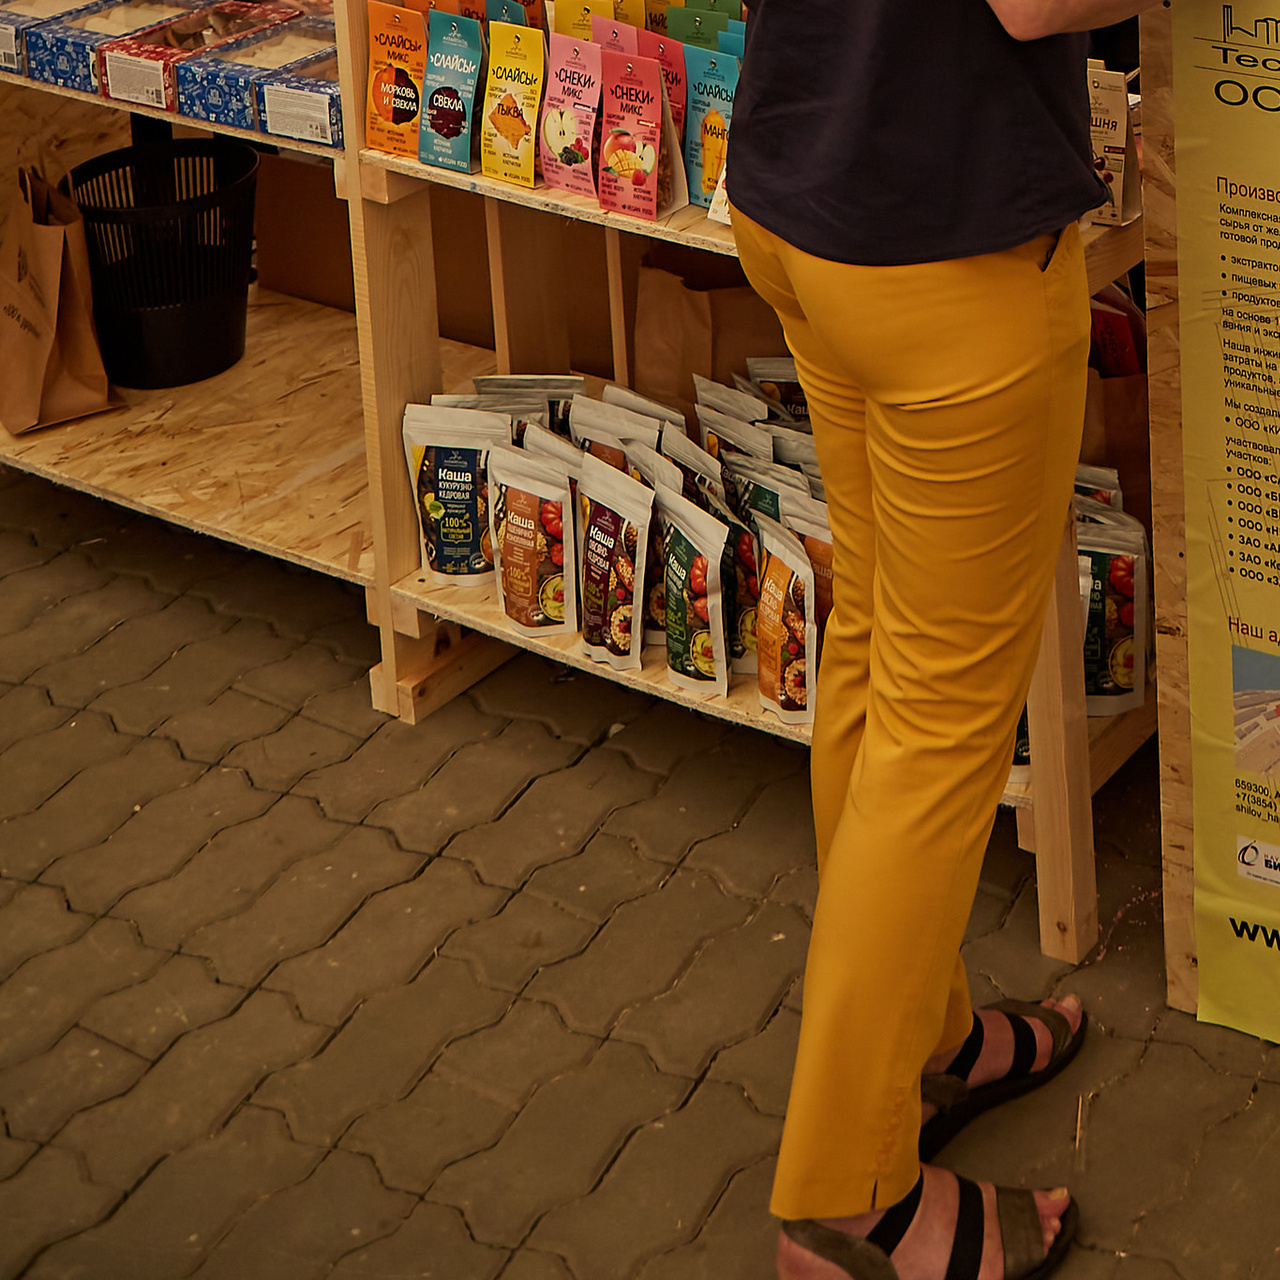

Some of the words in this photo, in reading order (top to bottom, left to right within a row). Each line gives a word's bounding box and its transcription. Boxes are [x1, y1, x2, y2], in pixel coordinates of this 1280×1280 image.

[379, 33, 417, 51] СЛАЙСЫ
[387, 50, 409, 63] МИКС
[433, 53, 472, 73] СЛАЙСЫ
[496, 66, 533, 86] СЛАЙСЫ
[558, 68, 591, 89] СНЕКИ
[381, 83, 415, 99] МОРКОВЬ
[561, 86, 583, 100] МИКС
[615, 85, 649, 104] СНЕКИ
[384, 96, 389, 105] И
[391, 98, 417, 112] СВЕКЛА
[433, 94, 463, 112] СВЕКЛА
[497, 103, 524, 120] ТЫКВА
[620, 102, 643, 116] МИКС
[1220, 218, 1250, 231] сырья
[1253, 224, 1264, 234] от
[1220, 231, 1257, 246] готовой
[1235, 417, 1260, 431] ООО
[438, 468, 472, 482] Каша
[439, 481, 474, 491] КУКУРУЗНО-
[439, 490, 470, 500] КЕДРОВАЯ
[507, 510, 535, 530] Каша
[589, 525, 615, 549] Каша
[669, 553, 687, 581] Каша
[764, 577, 784, 601] Каша
[1228, 616, 1263, 644] Наш
[1235, 778, 1272, 798] 659300,
[1236, 792, 1277, 811] +7(3854)
